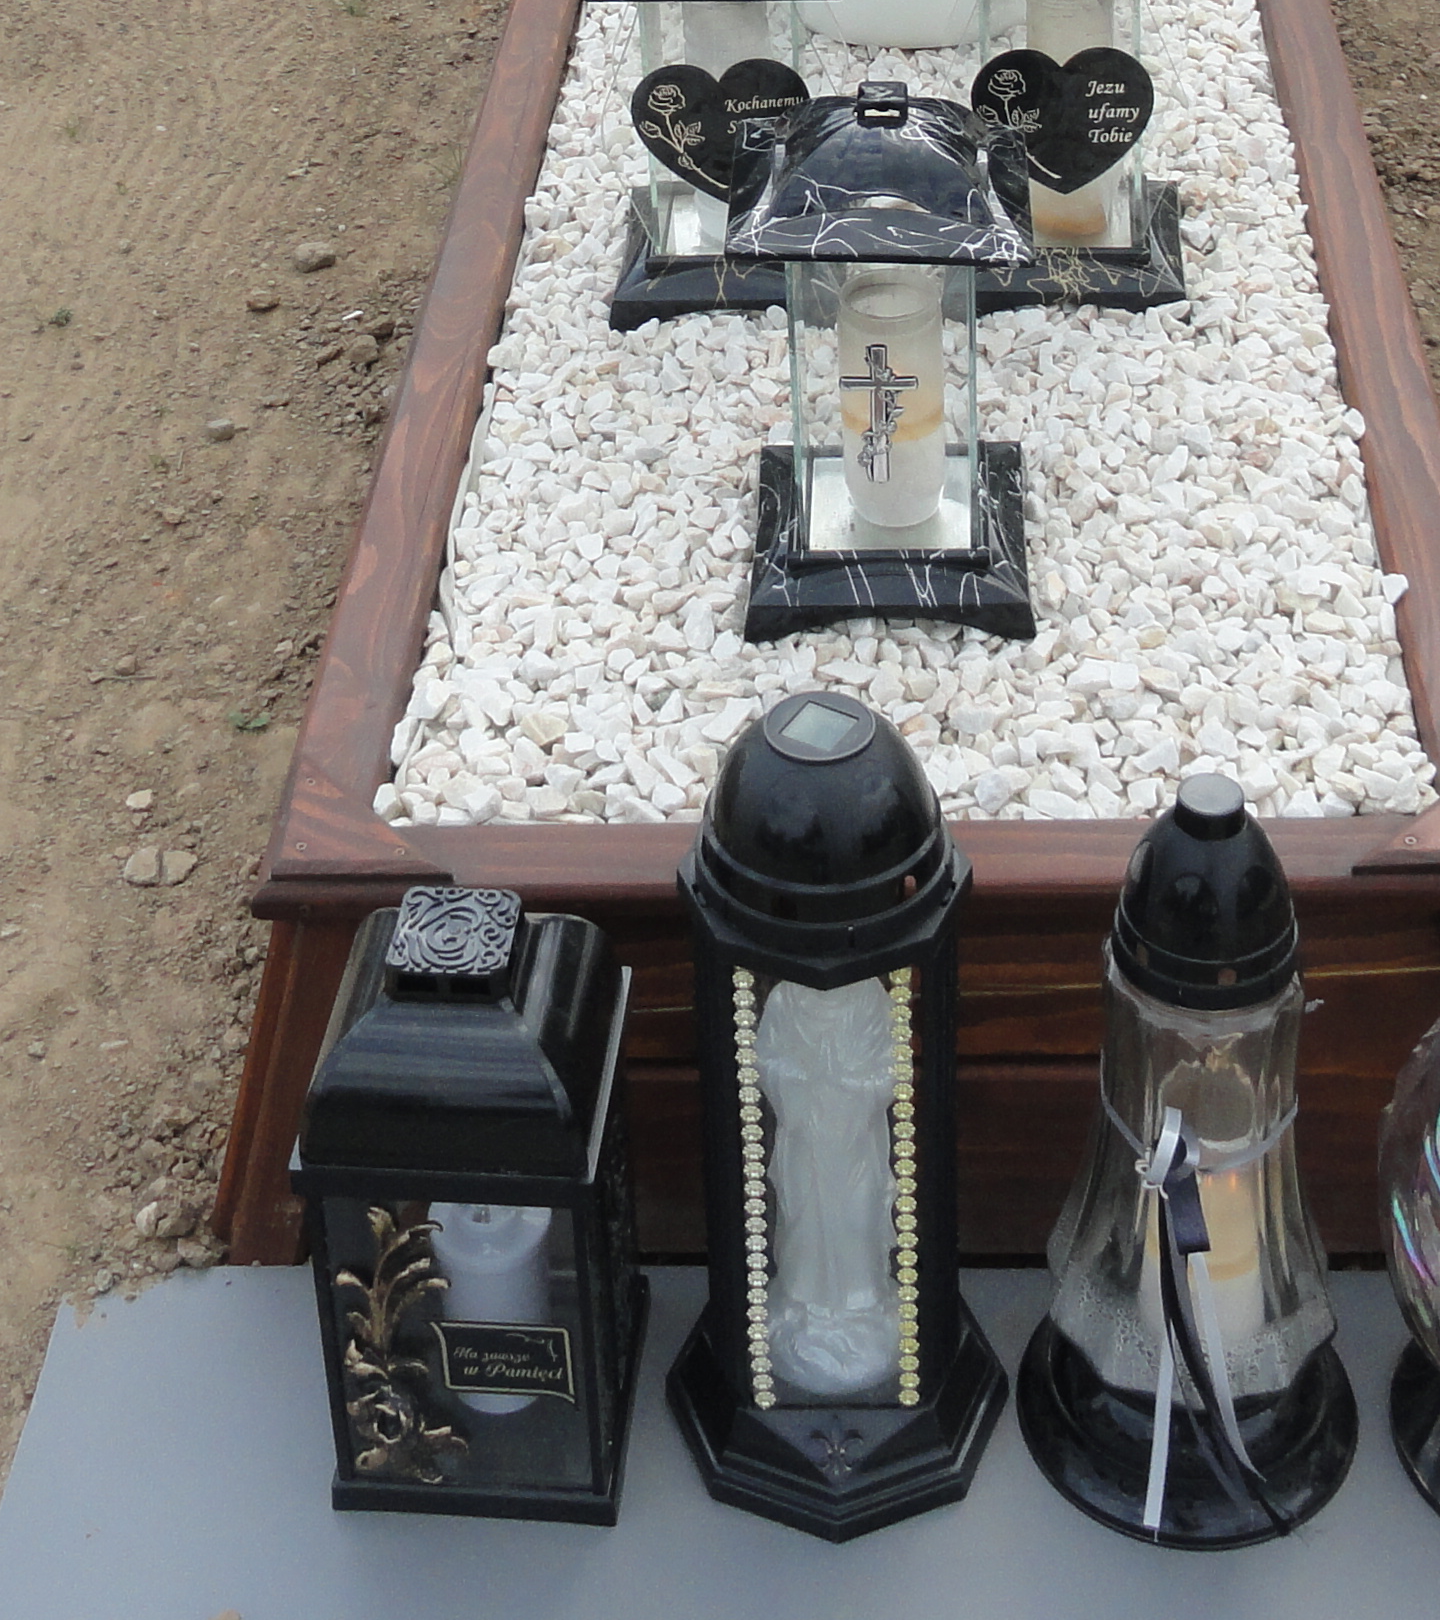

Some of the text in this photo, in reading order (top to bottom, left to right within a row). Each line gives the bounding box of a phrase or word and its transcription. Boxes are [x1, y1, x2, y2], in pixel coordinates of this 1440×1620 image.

[1084, 80, 1126, 97] Jezu
[724, 95, 804, 114] Kochanemu
[1087, 103, 1140, 123] ufamy
[1087, 128, 1134, 145] Tobie
